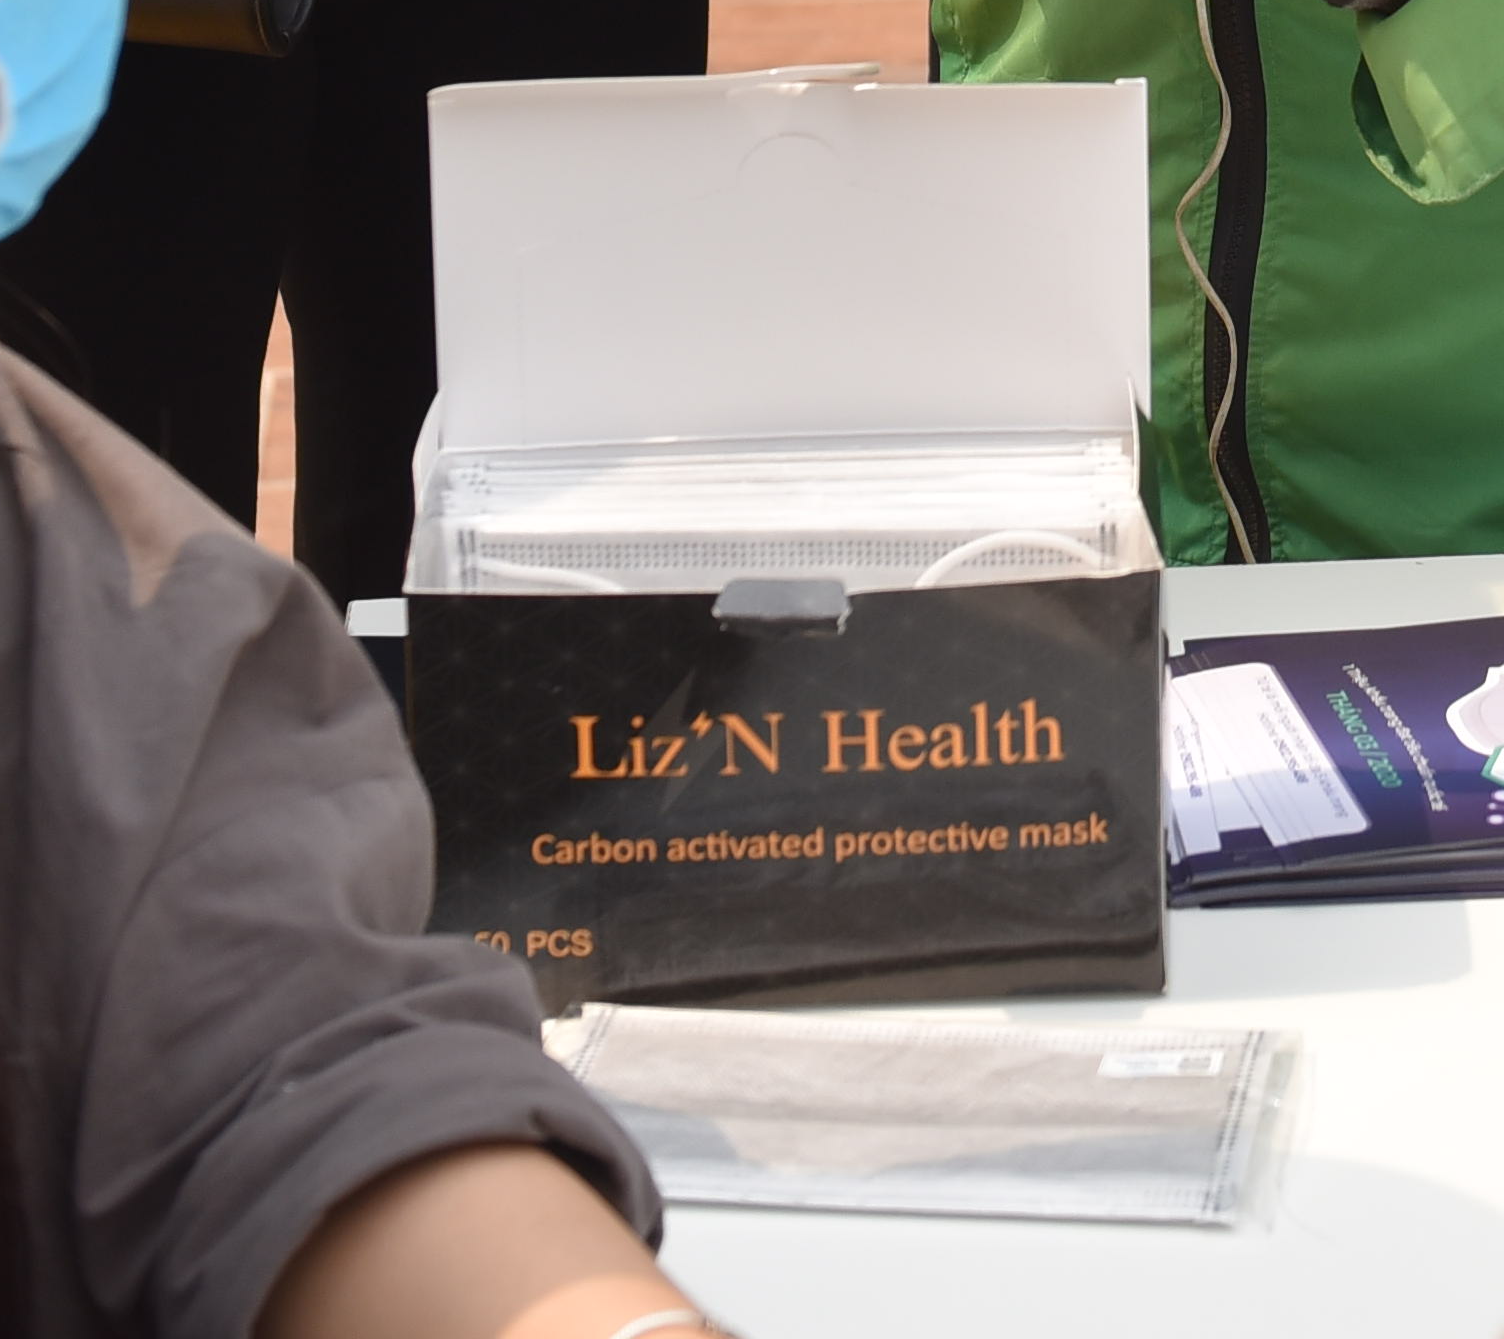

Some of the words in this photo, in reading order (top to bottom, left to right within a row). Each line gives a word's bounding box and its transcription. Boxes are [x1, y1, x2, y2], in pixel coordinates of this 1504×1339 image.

[568, 709, 785, 781] Liz'N
[819, 698, 1067, 775] Health
[530, 831, 658, 868] Carbon
[666, 827, 825, 864] activated
[834, 821, 1012, 862] protective
[1018, 811, 1110, 849] mask
[526, 928, 594, 958] PCS
